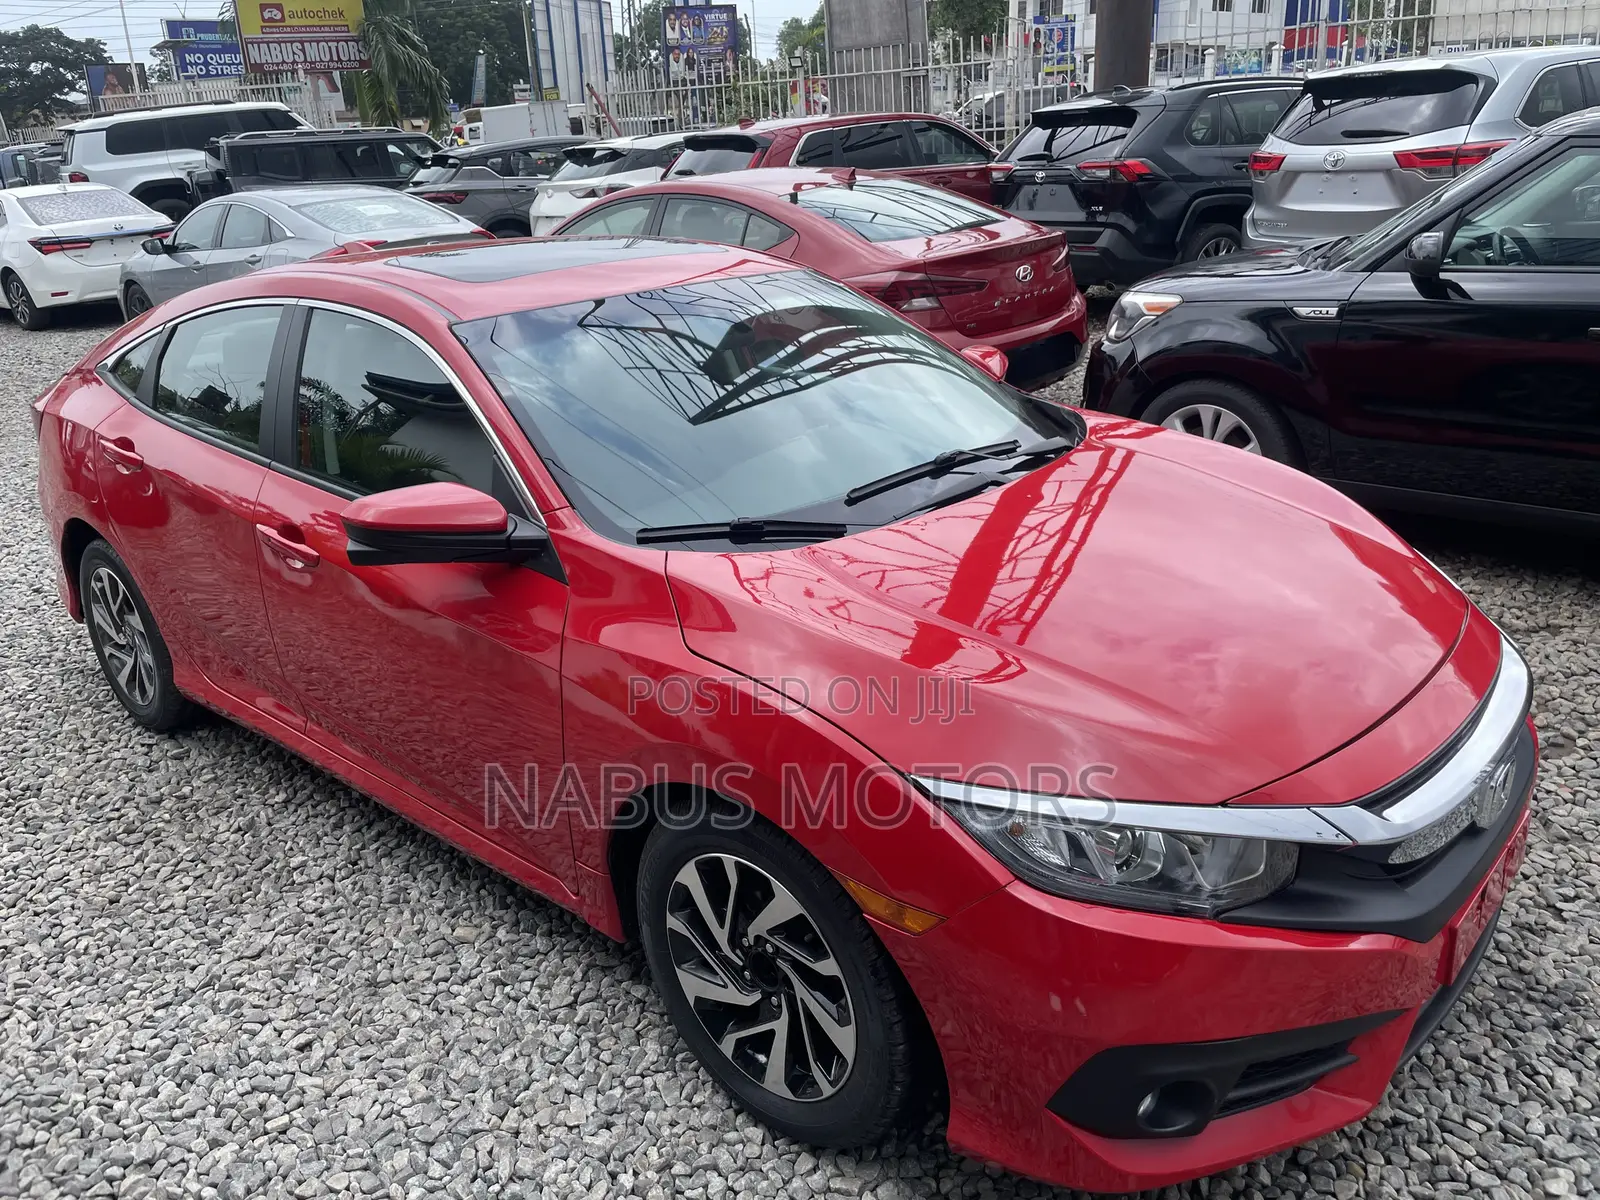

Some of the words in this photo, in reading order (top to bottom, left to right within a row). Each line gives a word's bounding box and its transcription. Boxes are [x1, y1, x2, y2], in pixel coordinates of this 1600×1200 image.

[288, 7, 346, 20] autochek
[247, 42, 304, 63] NABUS
[304, 41, 368, 62] MOTORS
[184, 53, 204, 63] NO
[206, 53, 244, 65] QUEU
[187, 65, 206, 75] NO
[209, 65, 246, 75] STRES
[293, 62, 310, 70] 450
[994, 285, 1055, 307] ELANTRA
